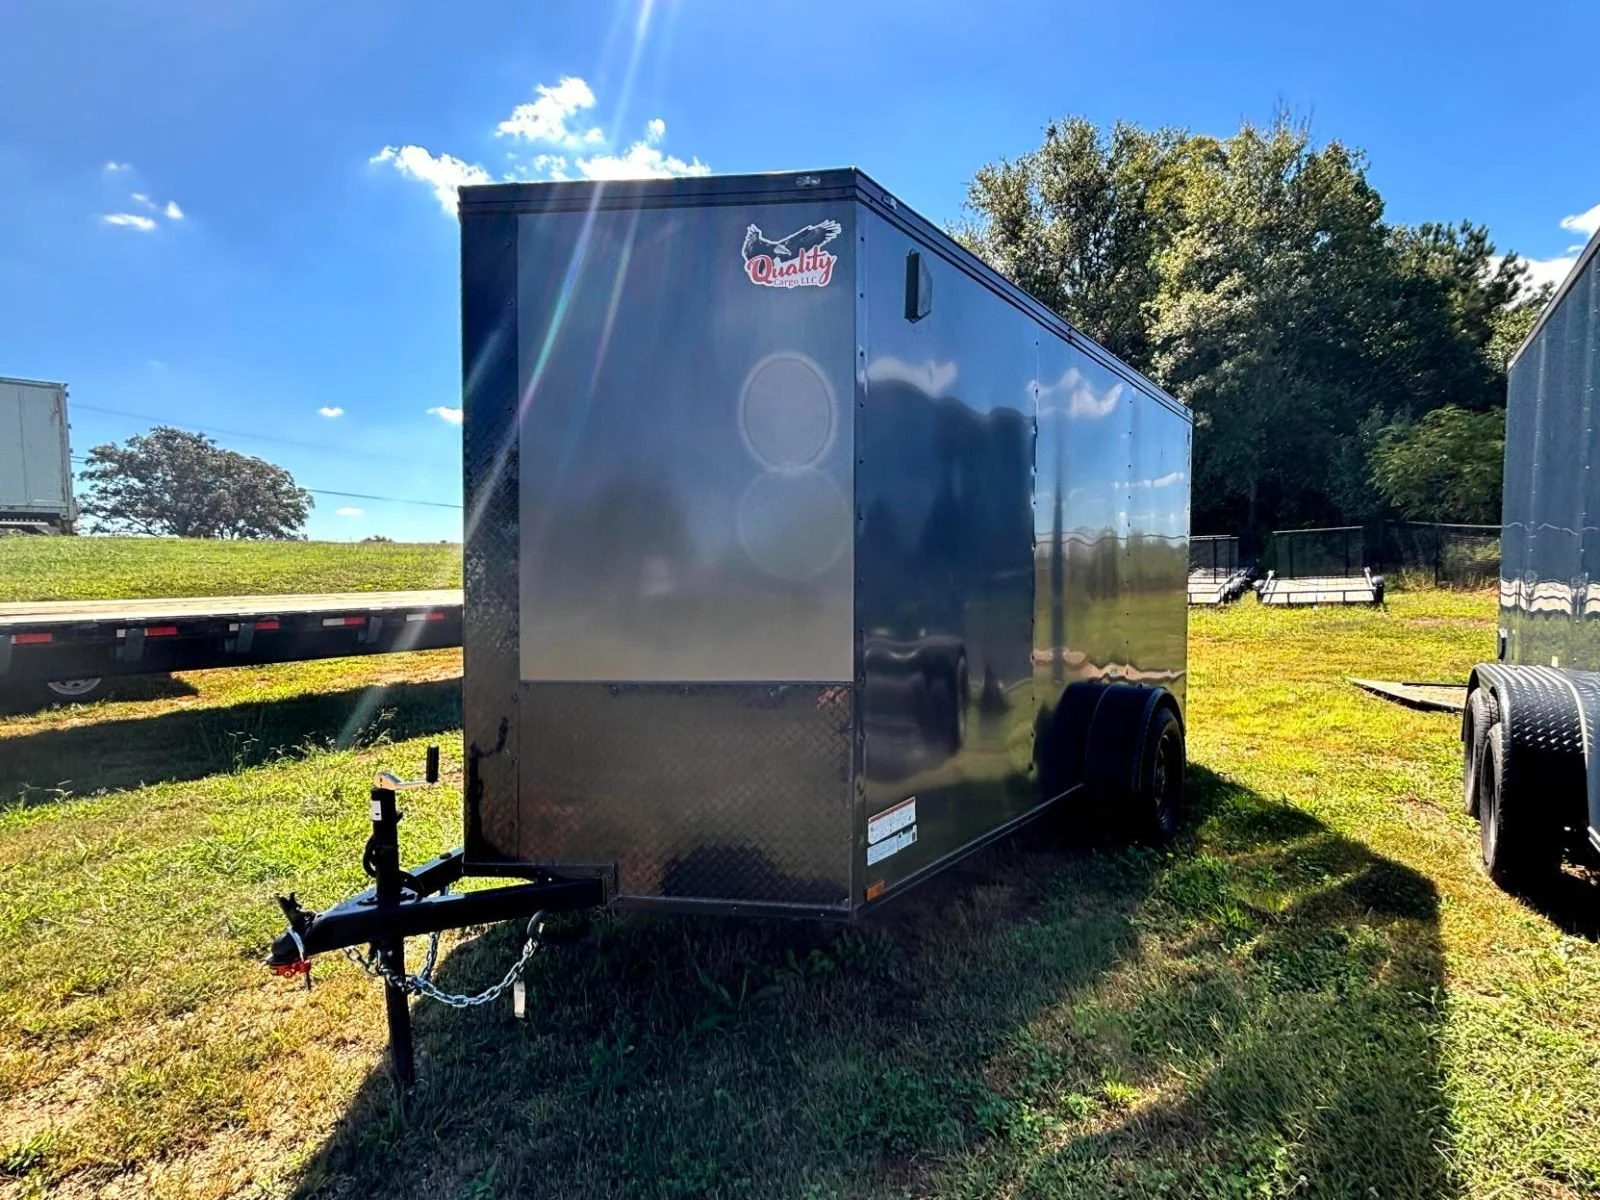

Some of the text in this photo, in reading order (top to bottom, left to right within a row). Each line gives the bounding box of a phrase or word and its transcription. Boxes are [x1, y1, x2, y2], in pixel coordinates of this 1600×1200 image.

[747, 245, 834, 284] Quality
[774, 276, 817, 286] Cargo LLC
